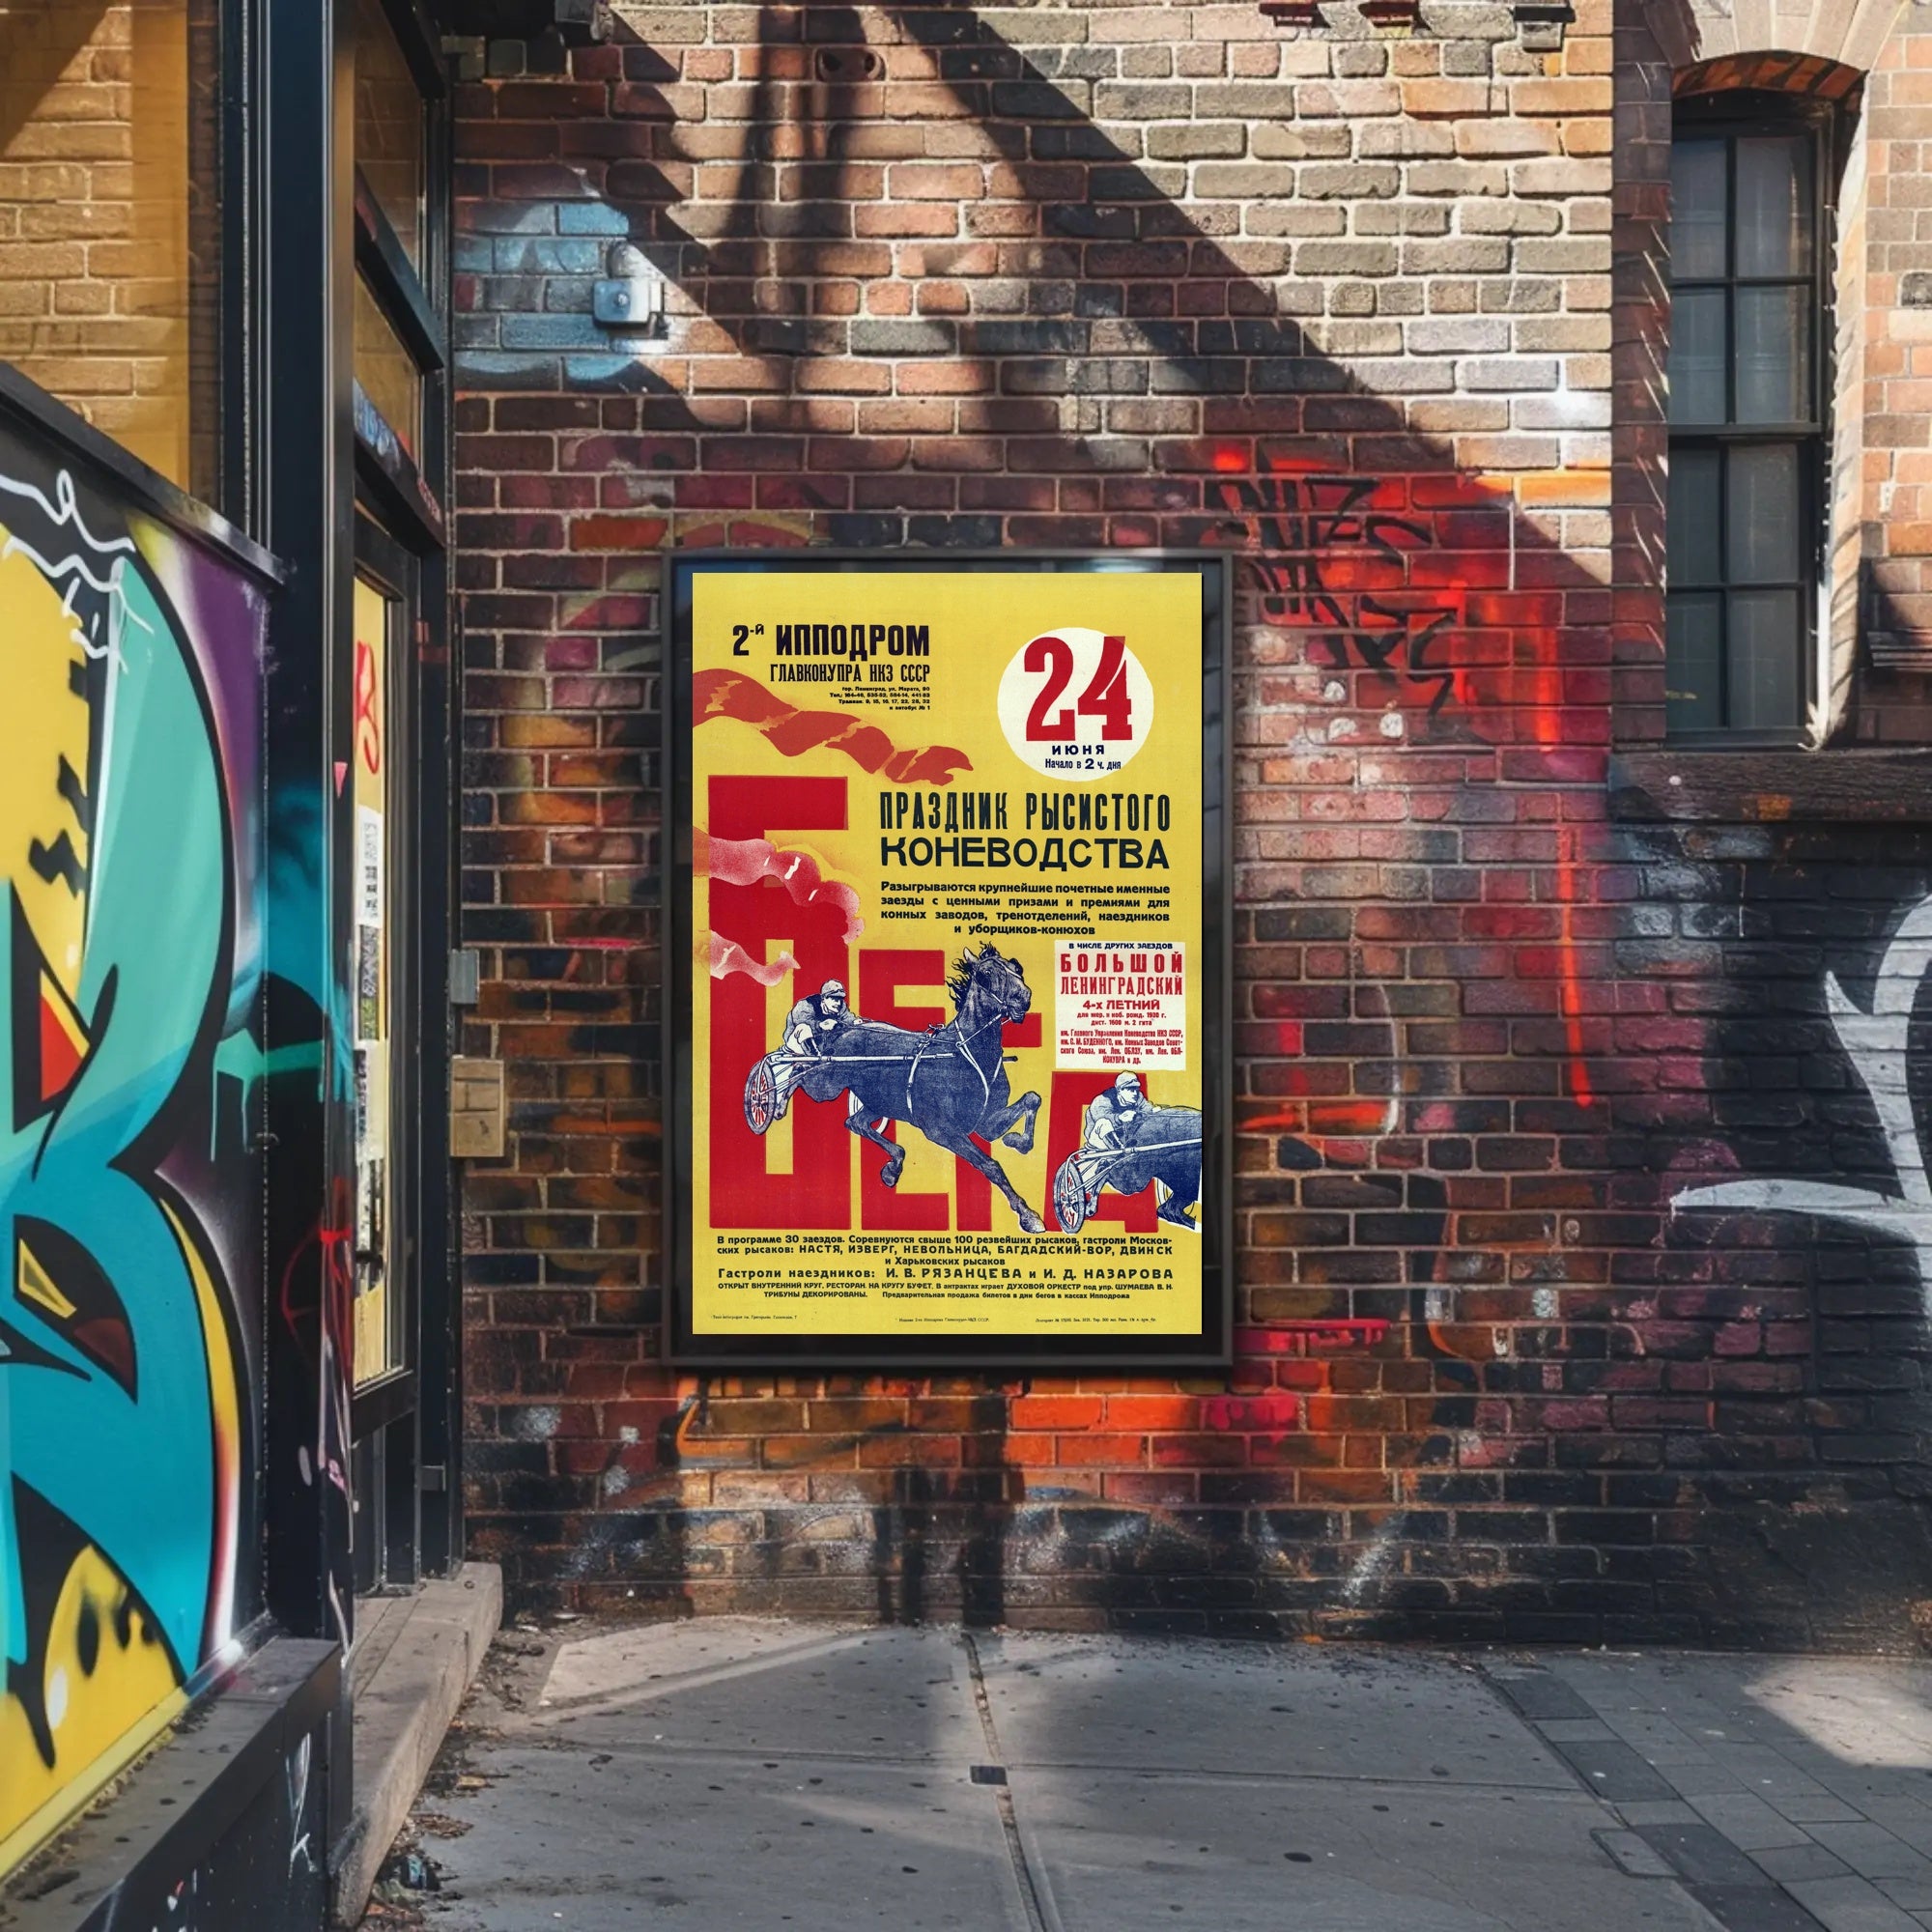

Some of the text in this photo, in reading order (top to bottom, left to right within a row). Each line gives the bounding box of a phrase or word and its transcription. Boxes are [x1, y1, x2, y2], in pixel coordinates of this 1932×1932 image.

[732, 624, 929, 662] 2-й ИППОДРОМ
[770, 664, 930, 682] ГЛАВКОНУПРА НКЗ СССР
[1024, 636, 1132, 742] 24
[1052, 745, 1104, 755] ИЮНЯ
[1045, 758, 1073, 769] Начало
[1085, 758, 1094, 770] 2
[1106, 761, 1122, 771] дня
[880, 792, 1170, 833] ПРАЗДНИК РЫСИСТОГО
[881, 837, 1170, 872] КОНЕВОДСТВА
[881, 881, 976, 894] Разыгрываются
[979, 883, 1053, 895] крупнейшие
[1055, 885, 1114, 894] почетные
[881, 897, 924, 907] заезды
[947, 897, 1000, 907] ценными
[1009, 898, 1059, 908] призами
[1081, 899, 1140, 908] премиями
[1148, 899, 1170, 908] для
[935, 912, 987, 922] заводов,
[996, 908, 1091, 923] тренотделений,
[1098, 913, 1170, 923] наездников
[969, 923, 1095, 936] уборщиков-конюхов
[1061, 952, 1182, 973] БОЛЬШОЙ
[1061, 975, 1182, 997] ЛЕНИНГРАДСКИЙ
[1083, 999, 1160, 1010] 4-х ЛЕТНИЙ
[717, 1236, 724, 1244] В
[728, 1236, 781, 1245] программе
[785, 1235, 799, 1243] 30
[848, 1235, 915, 1245] Соревнуются
[954, 1236, 973, 1244] 100
[977, 1236, 1032, 1245] резвейших
[1036, 1237, 1080, 1247] рысаков,
[1129, 1236, 1172, 1245] Москов-
[745, 1245, 794, 1255] рысаков:
[799, 1245, 843, 1255] НАСТЯ,
[848, 1245, 897, 1255] ИЗВЕРГ,
[903, 1245, 991, 1256] НЕВОЛЬНИЦА,
[998, 1245, 1115, 1256] БАГДАДСКИЙ-ВОР,
[1120, 1245, 1173, 1256] ДВИНСК
[895, 1257, 959, 1266] Харьковских
[719, 1268, 781, 1280] Гастроли
[789, 1270, 875, 1279] наездников:
[886, 1268, 898, 1278] И.
[904, 1267, 916, 1278] В.
[922, 1268, 1022, 1280] РЯЗАНЦЕВА
[1043, 1268, 1056, 1279] И.
[1063, 1268, 1076, 1281] Д.
[1084, 1268, 1173, 1279] НАЗАРОВА
